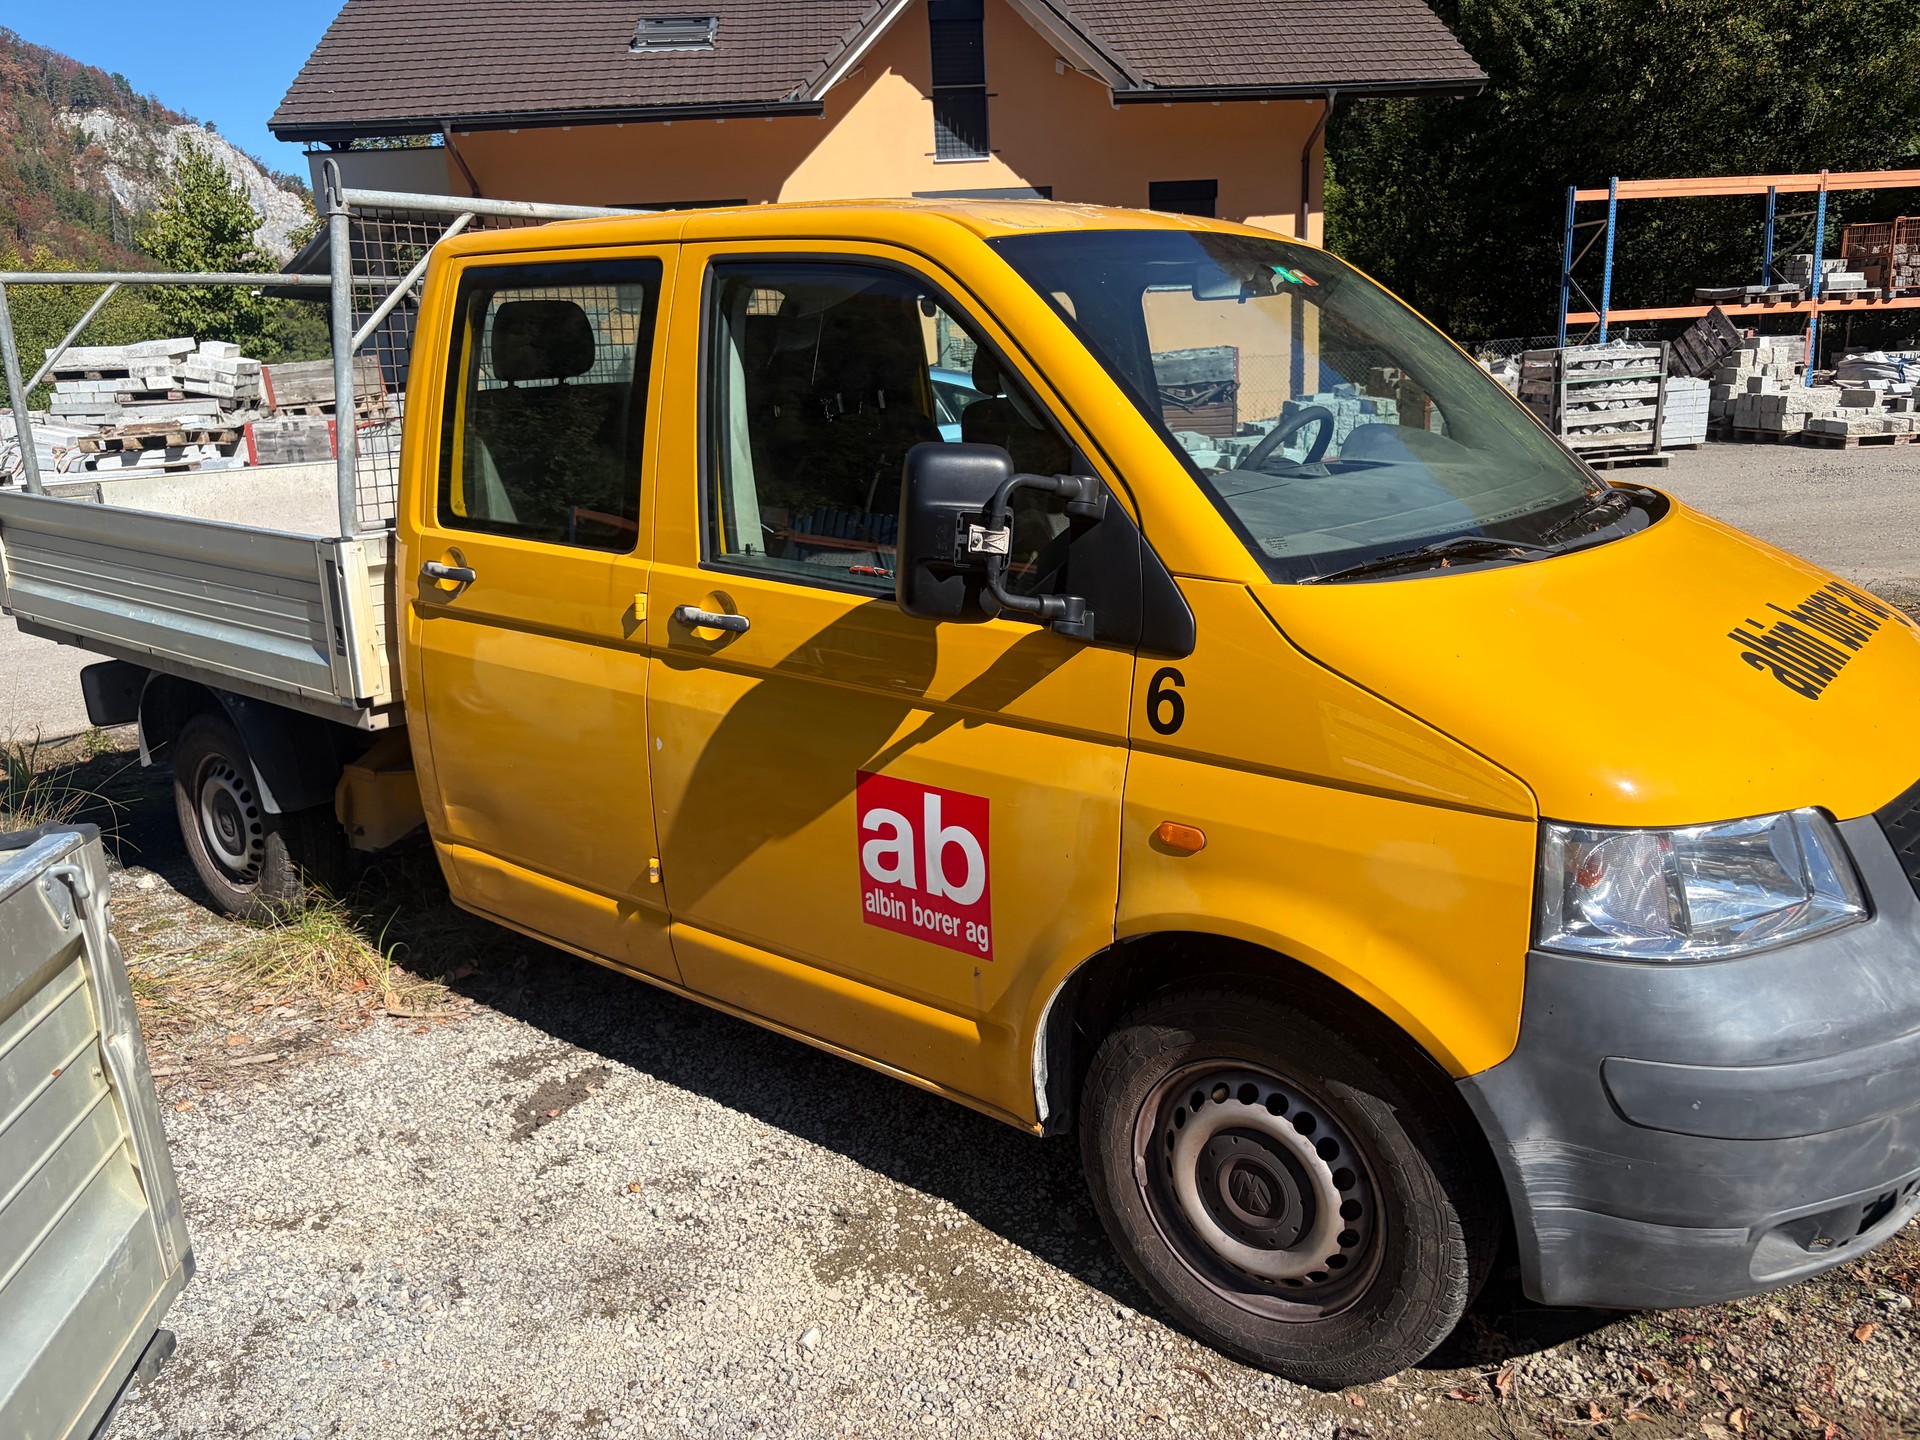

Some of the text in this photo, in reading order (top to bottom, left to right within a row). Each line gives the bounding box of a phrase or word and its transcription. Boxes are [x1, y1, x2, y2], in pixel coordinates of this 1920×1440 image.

[1727, 580, 1912, 701] albin borer ag
[1146, 666, 1186, 736] 6
[862, 791, 986, 906] ab
[865, 888, 989, 952] albin borer ag
